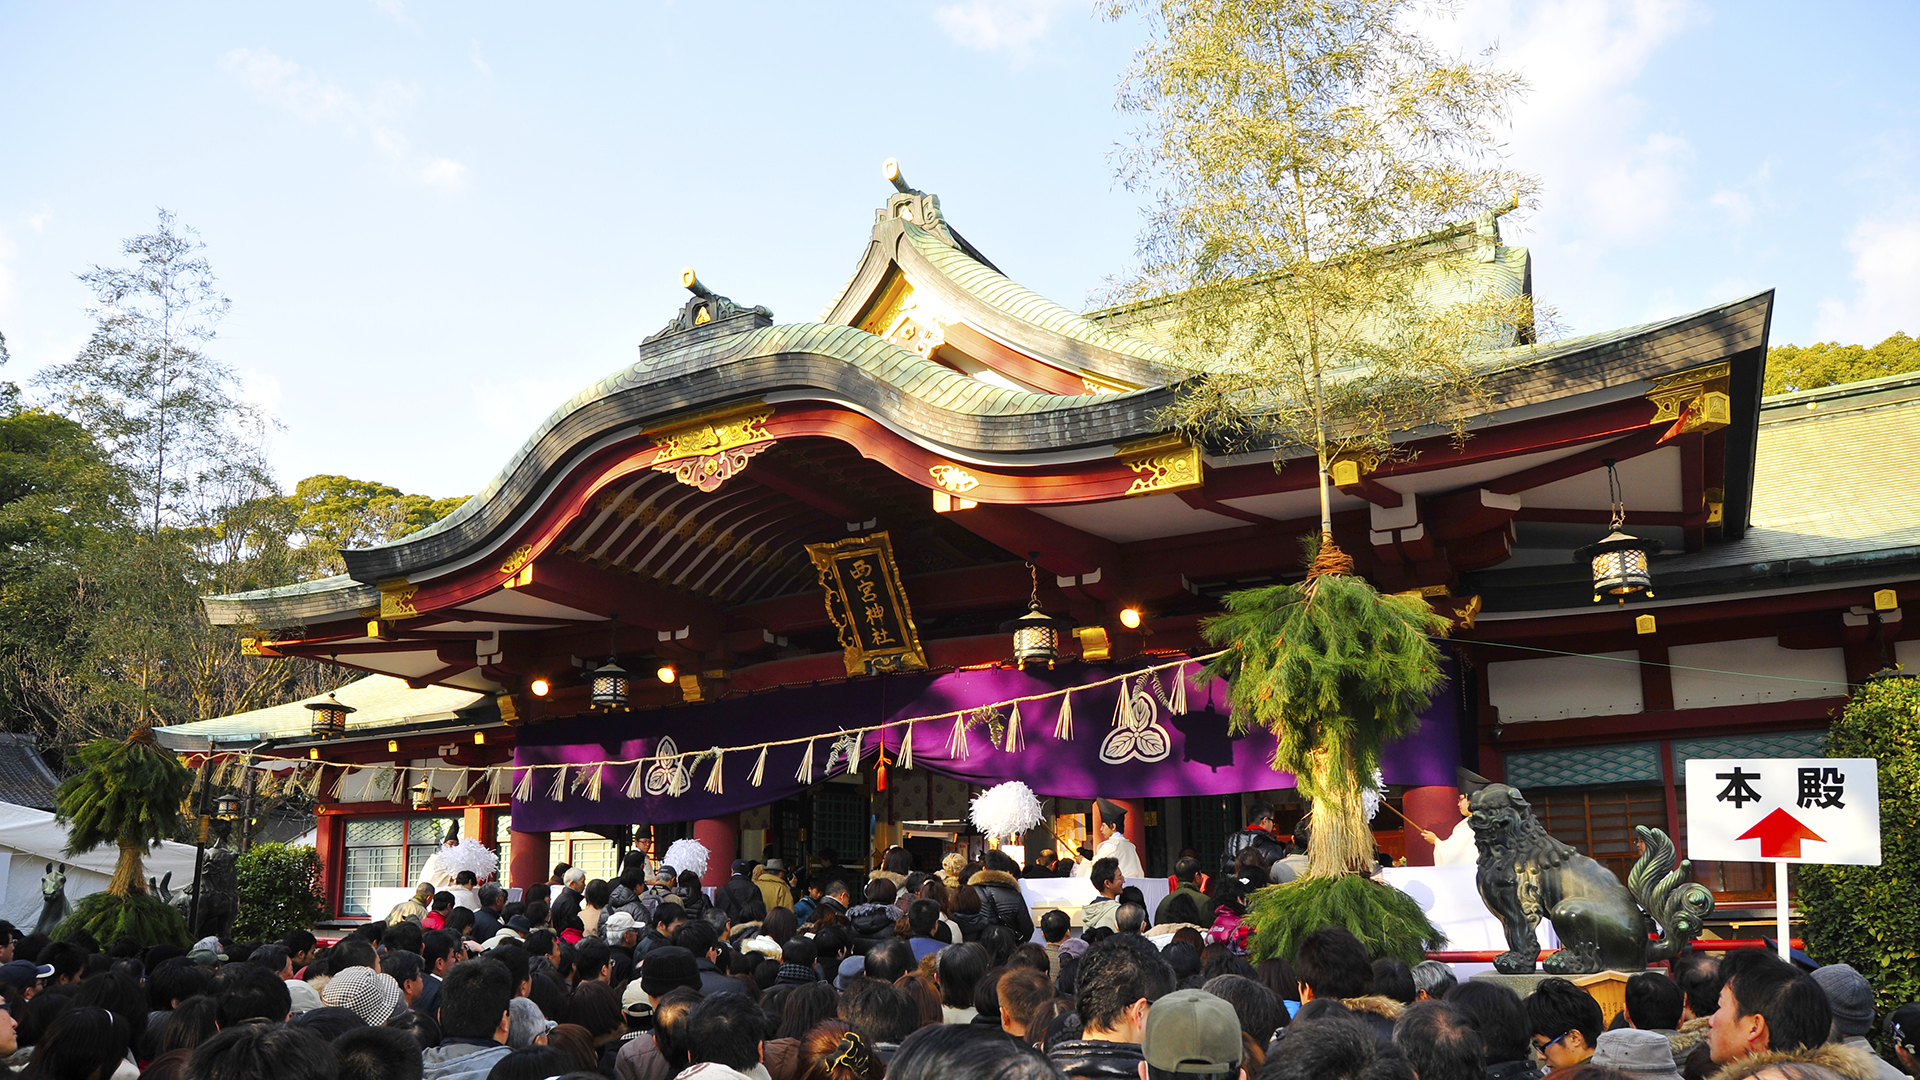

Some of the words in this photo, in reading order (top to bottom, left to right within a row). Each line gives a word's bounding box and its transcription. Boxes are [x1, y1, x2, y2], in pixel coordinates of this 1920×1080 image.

[849, 559, 896, 646] 西宮神社
[1715, 766, 1846, 810] 本殿
